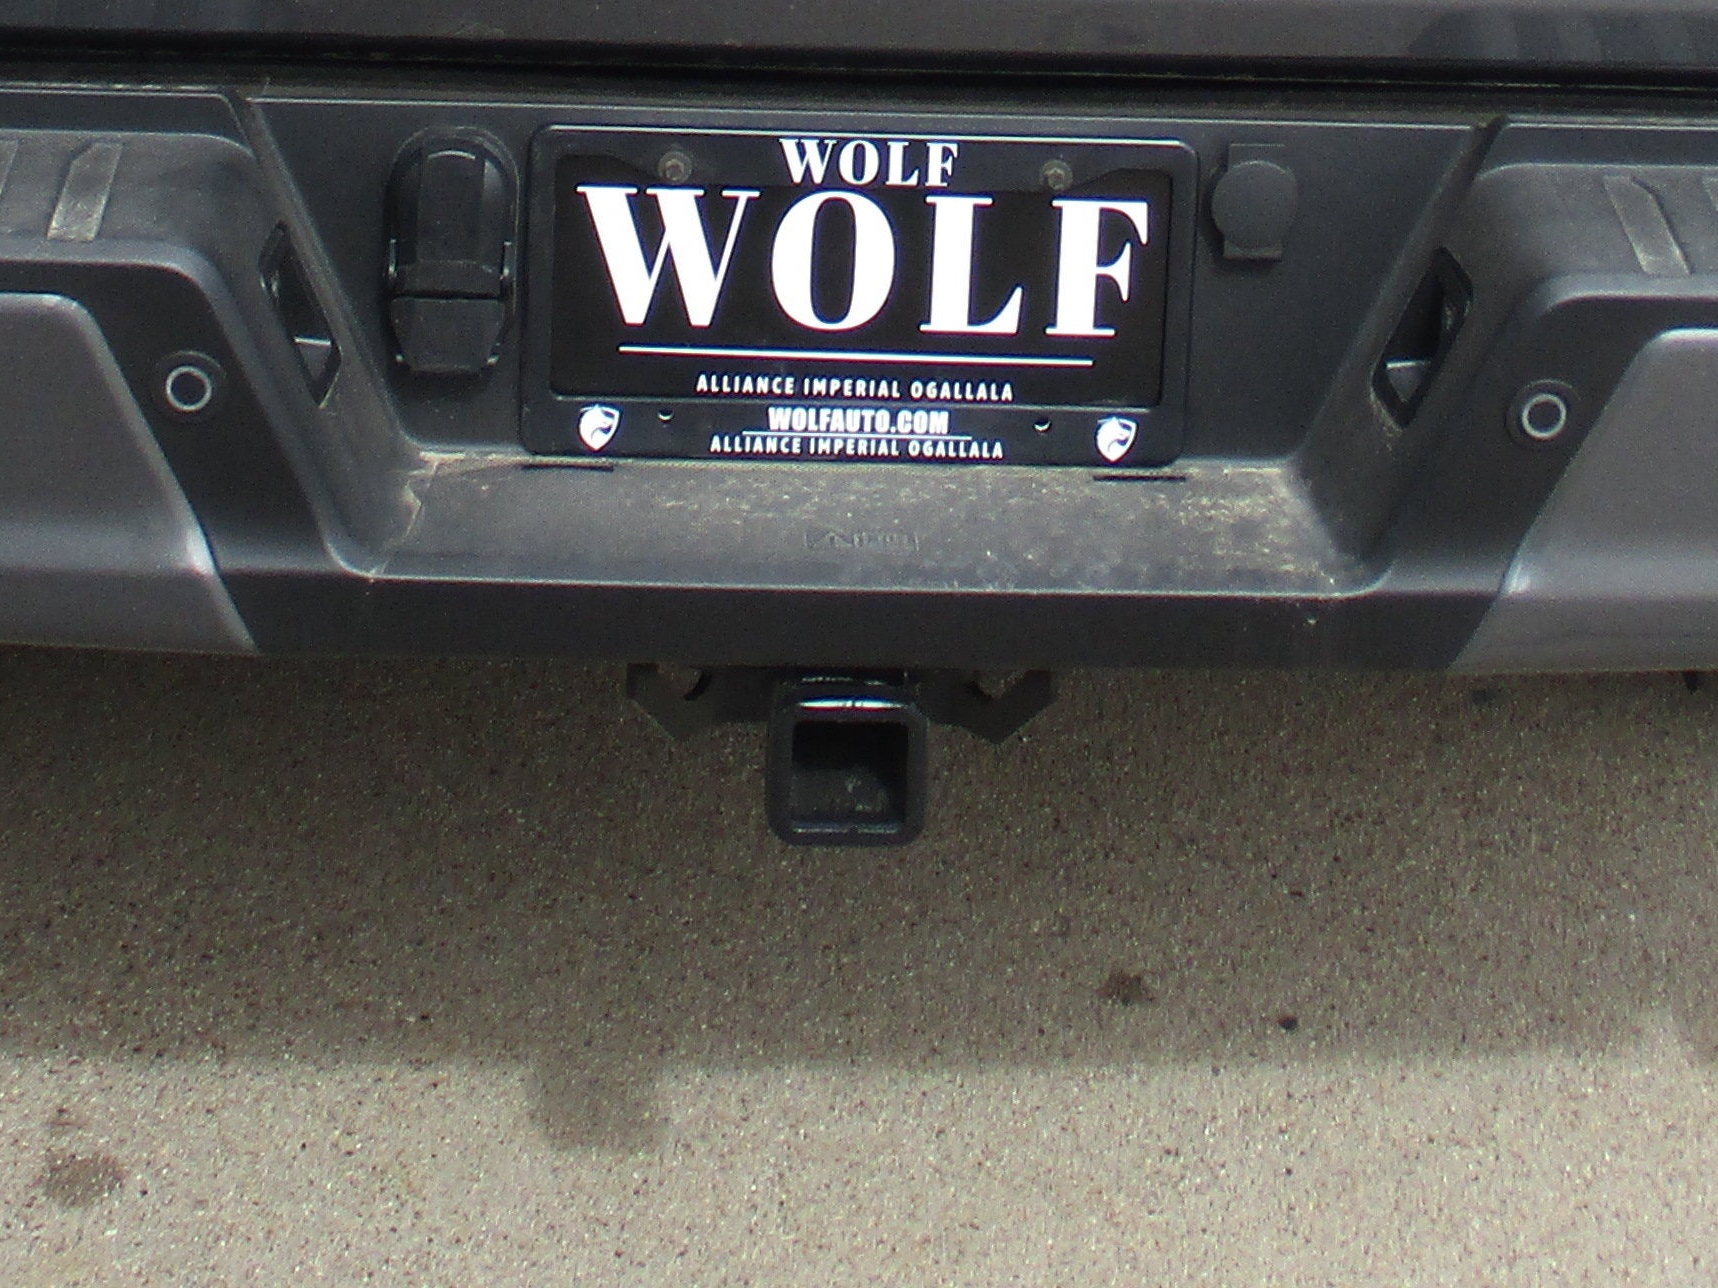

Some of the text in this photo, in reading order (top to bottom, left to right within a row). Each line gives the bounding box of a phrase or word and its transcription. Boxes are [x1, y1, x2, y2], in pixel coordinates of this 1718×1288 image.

[780, 137, 959, 188] WOLF
[576, 185, 1151, 337] WOLF
[695, 374, 1014, 402] ALLIANCE IMPERIAL OGALLALA
[767, 406, 950, 434] WOLFAUTO.COM
[709, 435, 1004, 459] ALLIANCE IMPERIAL OGALLALA
